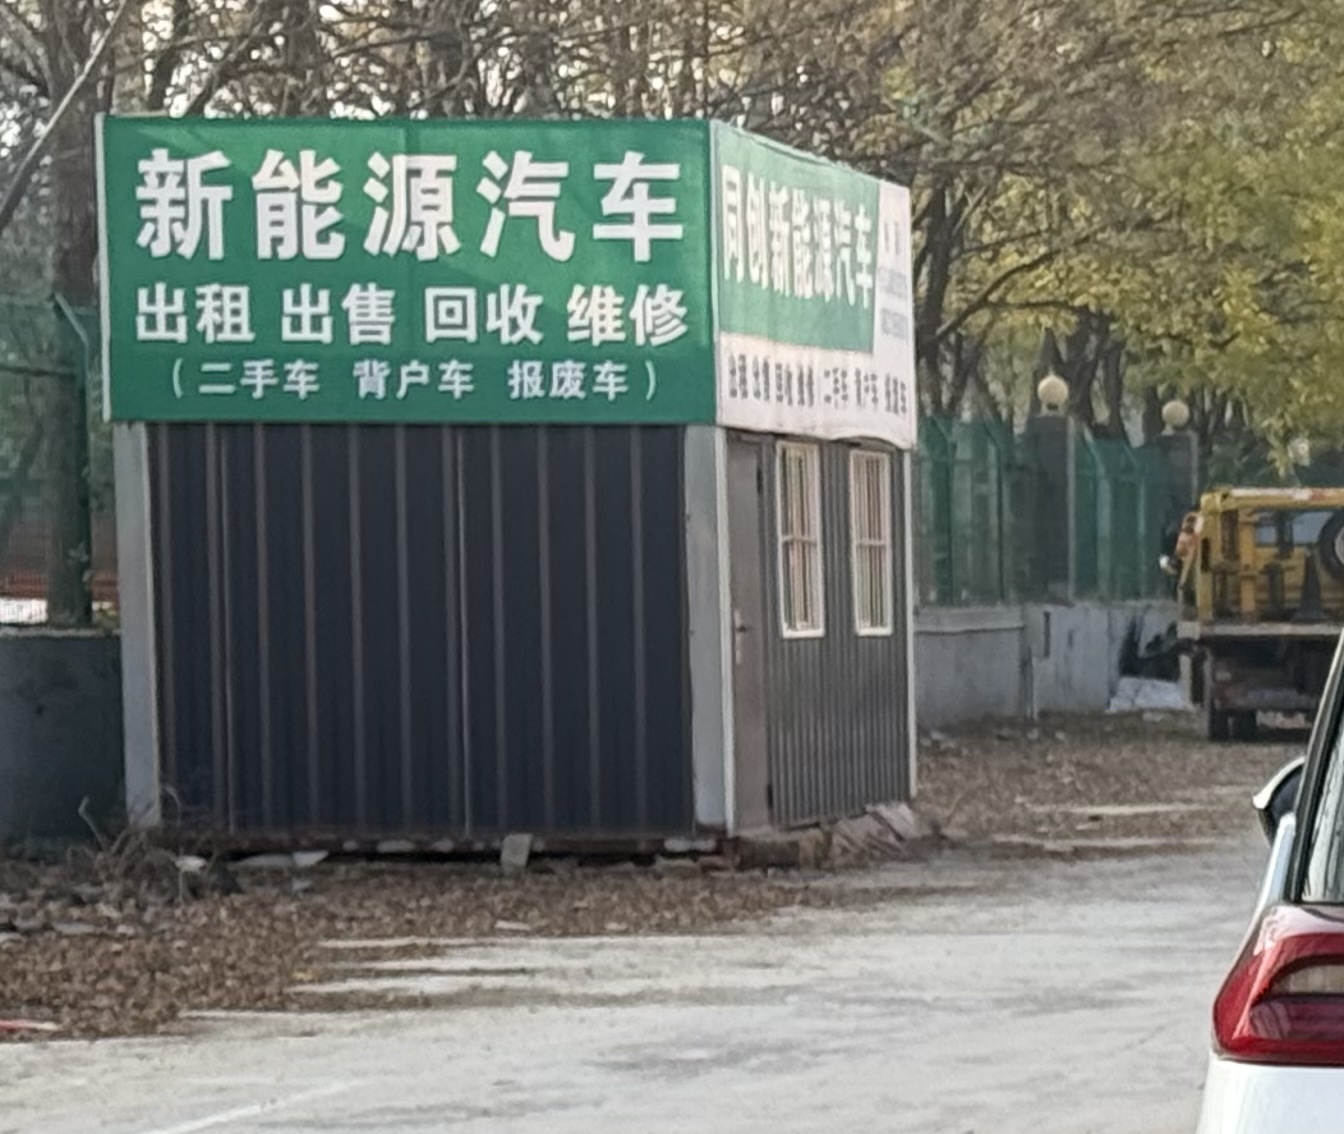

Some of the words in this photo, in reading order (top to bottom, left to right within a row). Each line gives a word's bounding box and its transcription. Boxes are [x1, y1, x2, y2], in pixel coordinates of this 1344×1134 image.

[136, 148, 683, 262] 新能源汽车
[136, 282, 255, 343] 出租
[281, 282, 396, 344] 出售
[425, 283, 544, 345] 回收
[567, 283, 688, 346] 维修
[353, 358, 474, 400] 背户车
